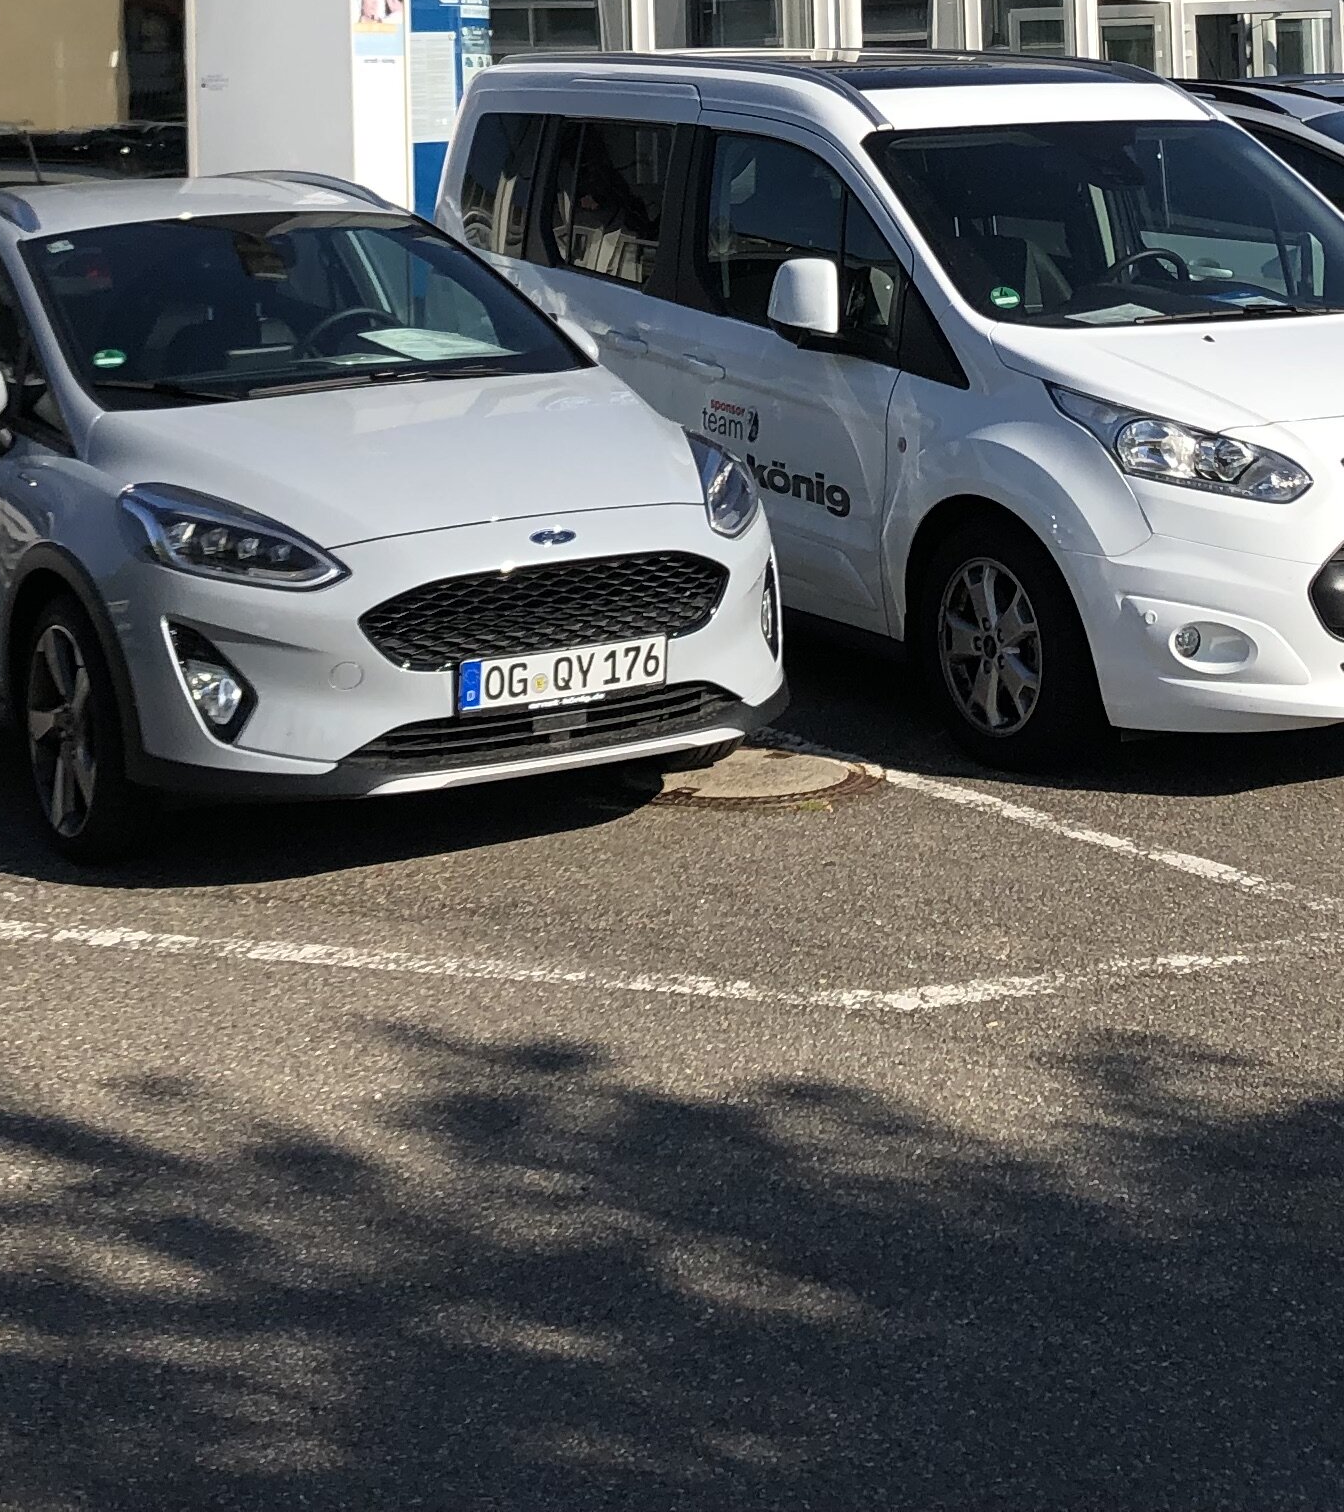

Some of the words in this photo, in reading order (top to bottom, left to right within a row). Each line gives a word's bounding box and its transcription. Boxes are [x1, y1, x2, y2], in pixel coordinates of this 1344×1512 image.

[702, 407, 744, 440] team
[710, 398, 746, 417] sponsor
[746, 453, 851, 518] könig
[466, 690, 476, 702] D
[485, 662, 529, 700] OG
[552, 652, 596, 691] QY
[602, 643, 661, 686] 176
